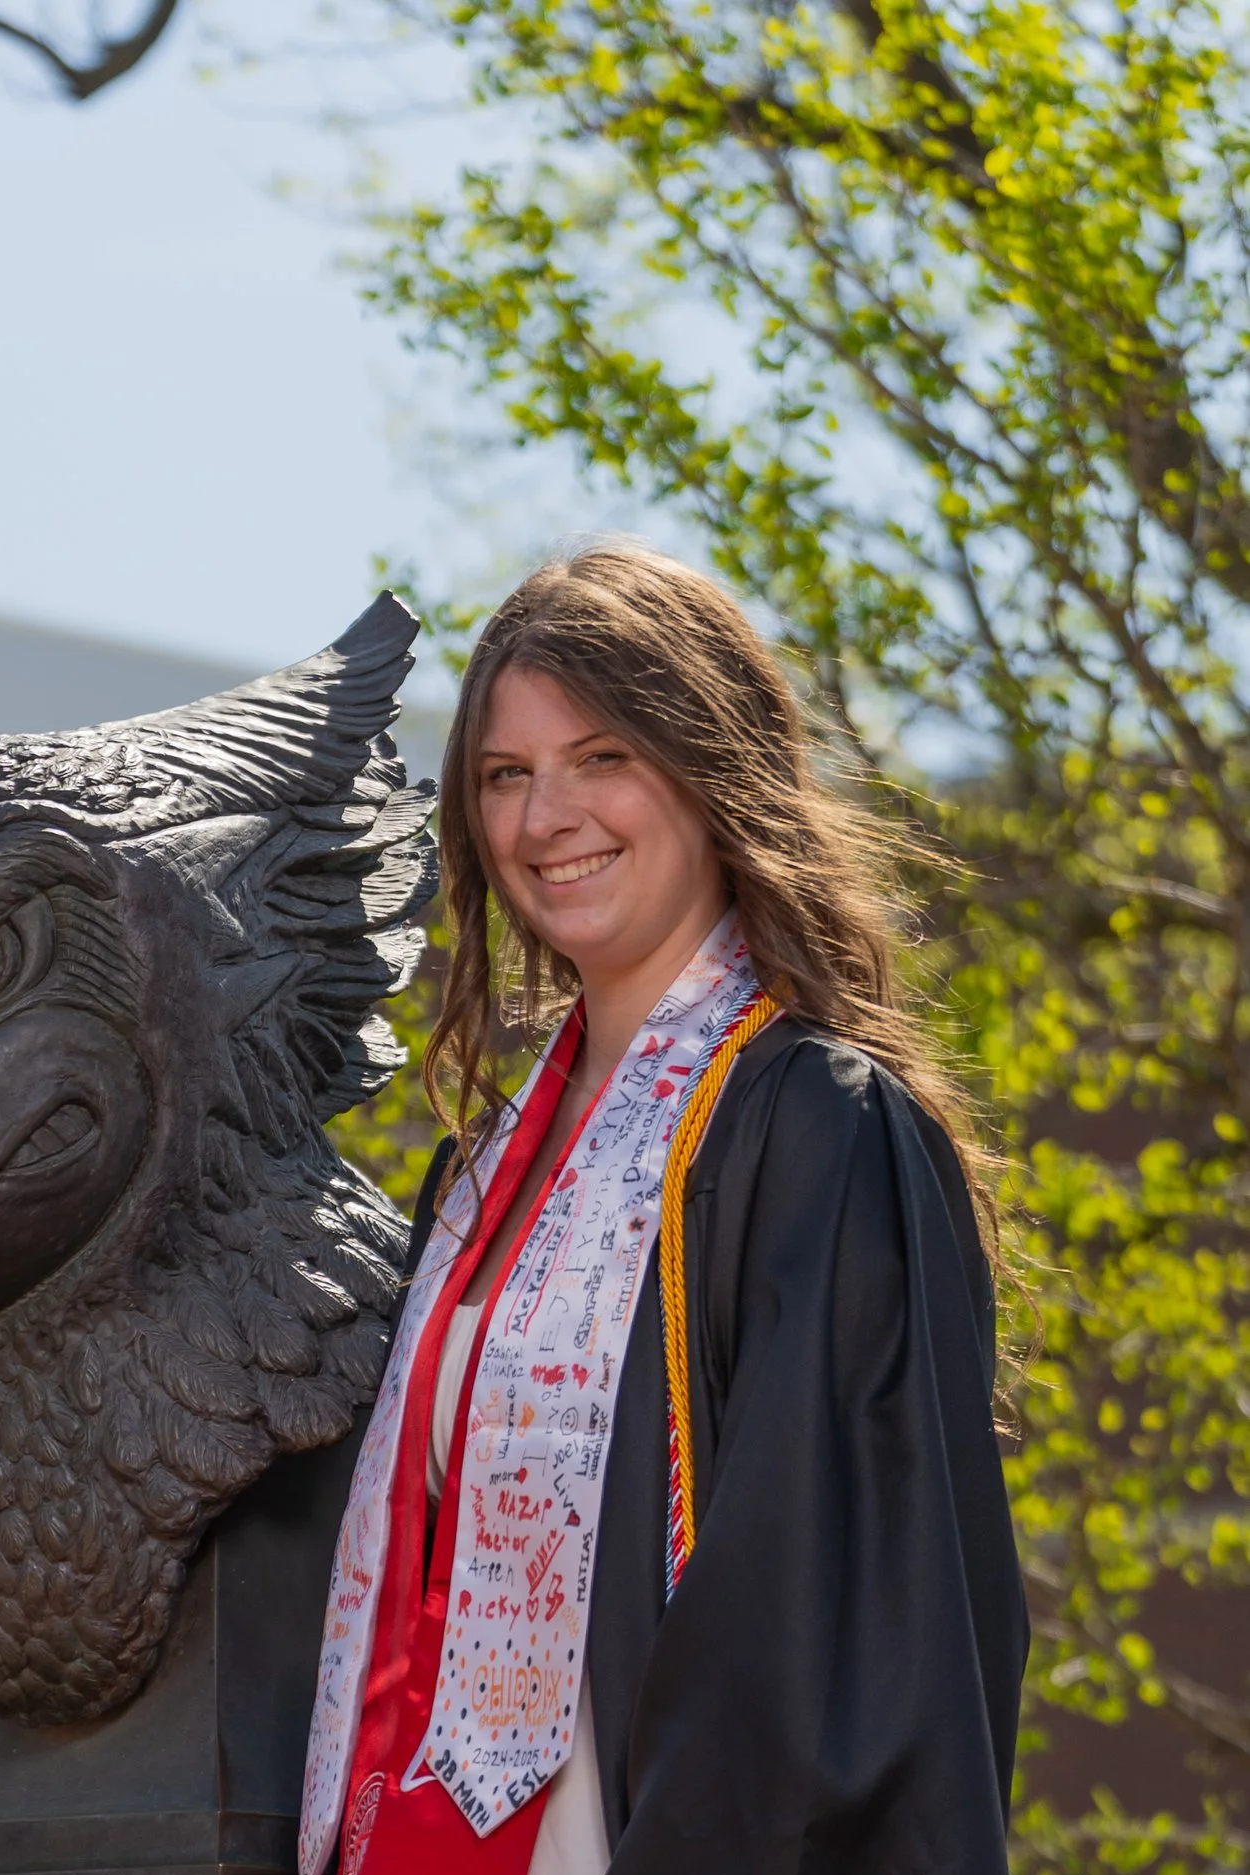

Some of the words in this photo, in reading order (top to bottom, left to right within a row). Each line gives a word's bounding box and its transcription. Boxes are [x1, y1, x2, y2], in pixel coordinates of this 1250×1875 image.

[471, 1664, 562, 1713] CHIDDIX
[471, 1747, 540, 1768] 2024-2025
[452, 1780, 491, 1829] MATH
[506, 1767, 548, 1810] ESL
